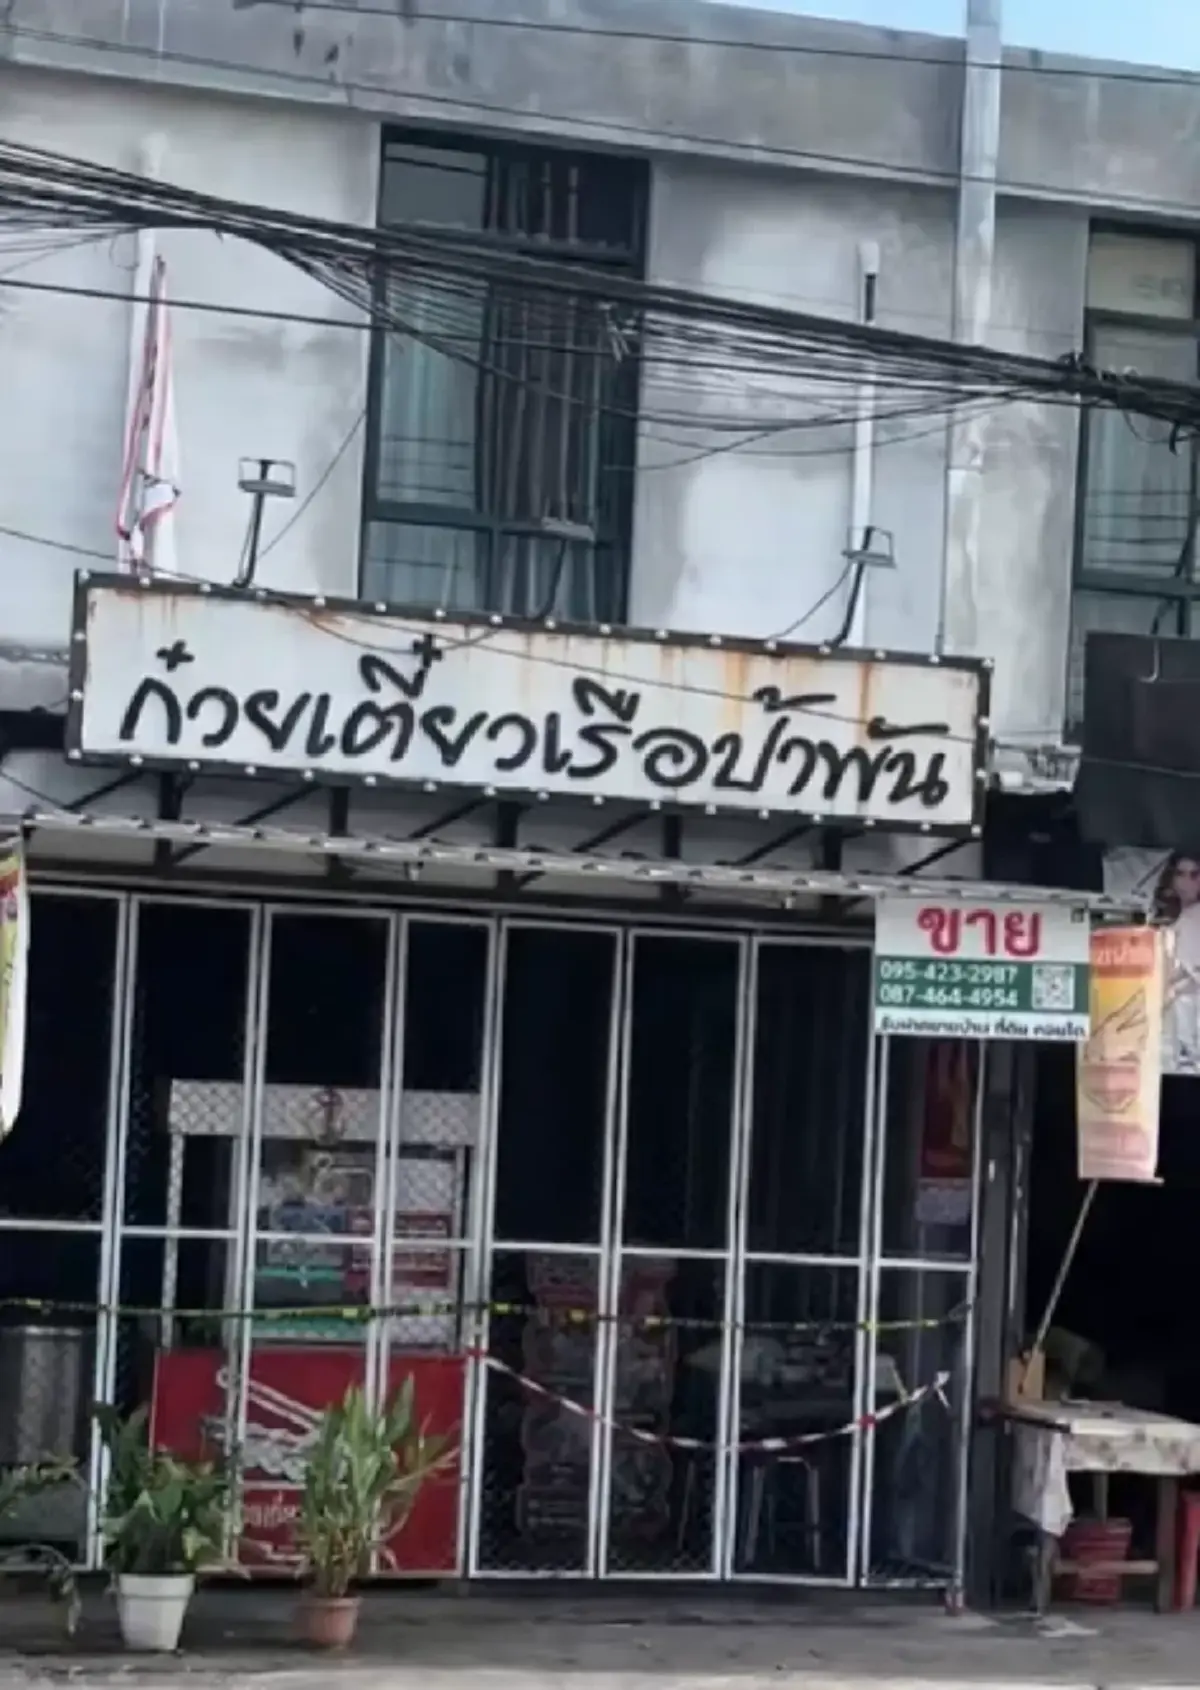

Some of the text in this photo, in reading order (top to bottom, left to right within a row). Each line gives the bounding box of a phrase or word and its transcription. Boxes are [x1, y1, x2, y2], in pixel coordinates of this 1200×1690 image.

[119, 633, 951, 806] ก๋วยเตี๋ยวเรือป้าพัน
[918, 906, 1040, 957] ขาย
[881, 961, 1018, 984] 095-423-2987
[881, 985, 1018, 1007] 087-464-4954
